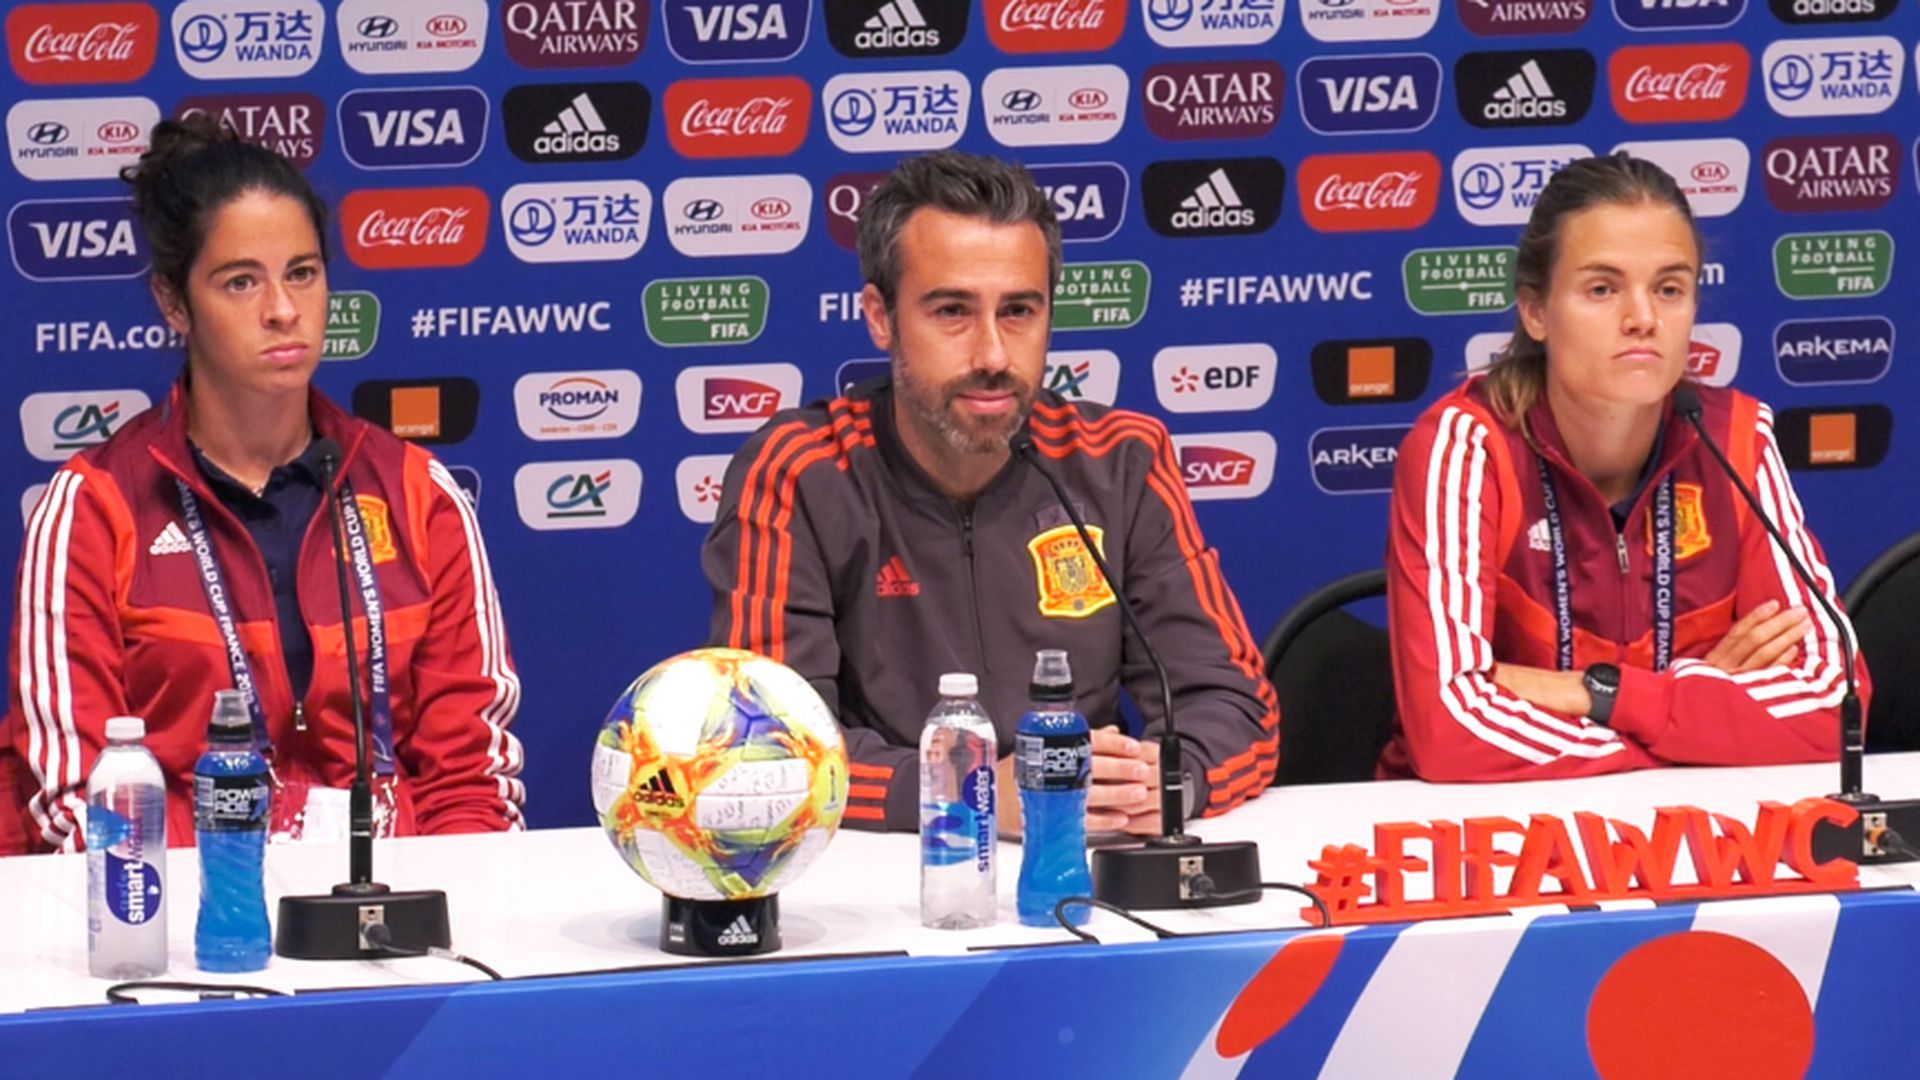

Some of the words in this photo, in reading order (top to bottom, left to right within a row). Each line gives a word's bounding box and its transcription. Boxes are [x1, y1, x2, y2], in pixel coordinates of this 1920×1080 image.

[506, 0, 637, 34] QATAR
[684, 3, 788, 42] VISA
[1000, 0, 1107, 32] Coca-Cola
[1200, 12, 1275, 30] WANDA
[1308, 9, 1365, 20] HYUNDAI
[1491, 0, 1586, 22] AIRWAYS
[235, 11, 313, 42] 万达
[854, 27, 940, 49] adidas
[24, 22, 140, 63] Coca-Cola
[235, 44, 312, 62] WANDA
[348, 40, 408, 52] HYUNDAI
[540, 32, 639, 54] AIRWAYS
[1820, 50, 1894, 81] 万达
[1146, 72, 1273, 106] QATAR
[1317, 75, 1418, 114] VISA
[1625, 63, 1733, 103] Coca-Cola
[1821, 80, 1892, 99] WANDA
[884, 84, 959, 116] 万达
[1484, 98, 1567, 120] adidas
[681, 97, 793, 137] Coca-Cola
[884, 117, 959, 136] WANDA
[993, 112, 1051, 125] HYUNDAI
[1178, 104, 1274, 127] AIRWAYS
[358, 109, 465, 148] VISA
[18, 147, 79, 159] HYUNDAI
[534, 131, 620, 154] adidas
[1767, 145, 1890, 182] QATAR
[1314, 172, 1423, 211] Coca-Cola
[1796, 177, 1891, 199] AIRWAYS
[563, 193, 639, 226] 万达
[1036, 184, 1105, 221] SA
[357, 206, 470, 248] Coca-Cola
[675, 223, 733, 235] HYUNDAI
[1171, 206, 1255, 229] adidas
[28, 219, 137, 259] VISA
[564, 227, 640, 245] WANDA
[1791, 237, 1877, 252] LIVING
[1421, 253, 1507, 269] LIVING
[1791, 250, 1875, 266] FOOTBALL
[1059, 267, 1132, 282] IVING
[1421, 266, 1506, 281] FOOTBALL
[1837, 274, 1875, 292] FIFA
[661, 283, 750, 298] LIVING
[1055, 281, 1131, 296] OOTBALL
[1180, 271, 1372, 308] #FIFAWWC
[1467, 291, 1506, 308] FIFA
[661, 296, 749, 312] FOOTBALL
[1092, 307, 1131, 323] FIFA
[411, 302, 611, 338] #FIFAWWC
[710, 323, 749, 339] FIFA
[36, 321, 184, 352] FIFA.co
[1779, 336, 1889, 360] ARKEMA
[539, 389, 619, 406] PROMAN
[1350, 383, 1392, 395] orange
[707, 392, 776, 415] SNCF
[395, 424, 436, 436] orange
[1314, 443, 1399, 468] ARKE
[1184, 460, 1251, 482] SNCF
[1655, 475, 1671, 529] MEN'S
[343, 505, 361, 535] CUP
[350, 535, 375, 588] WORLD
[1656, 530, 1671, 587] WORLD
[192, 530, 218, 583] WORLD
[209, 583, 228, 614] CUP
[219, 615, 248, 672] FRANCE
[1656, 587, 1671, 620] CUP
[362, 588, 384, 660] WOMEN'S
[1656, 622, 1670, 674] FRANC
[372, 661, 386, 693] FIFA
[633, 791, 684, 809] adidas
[1303, 797, 1861, 912] #FIFAWWC
[717, 932, 759, 946] adidas
